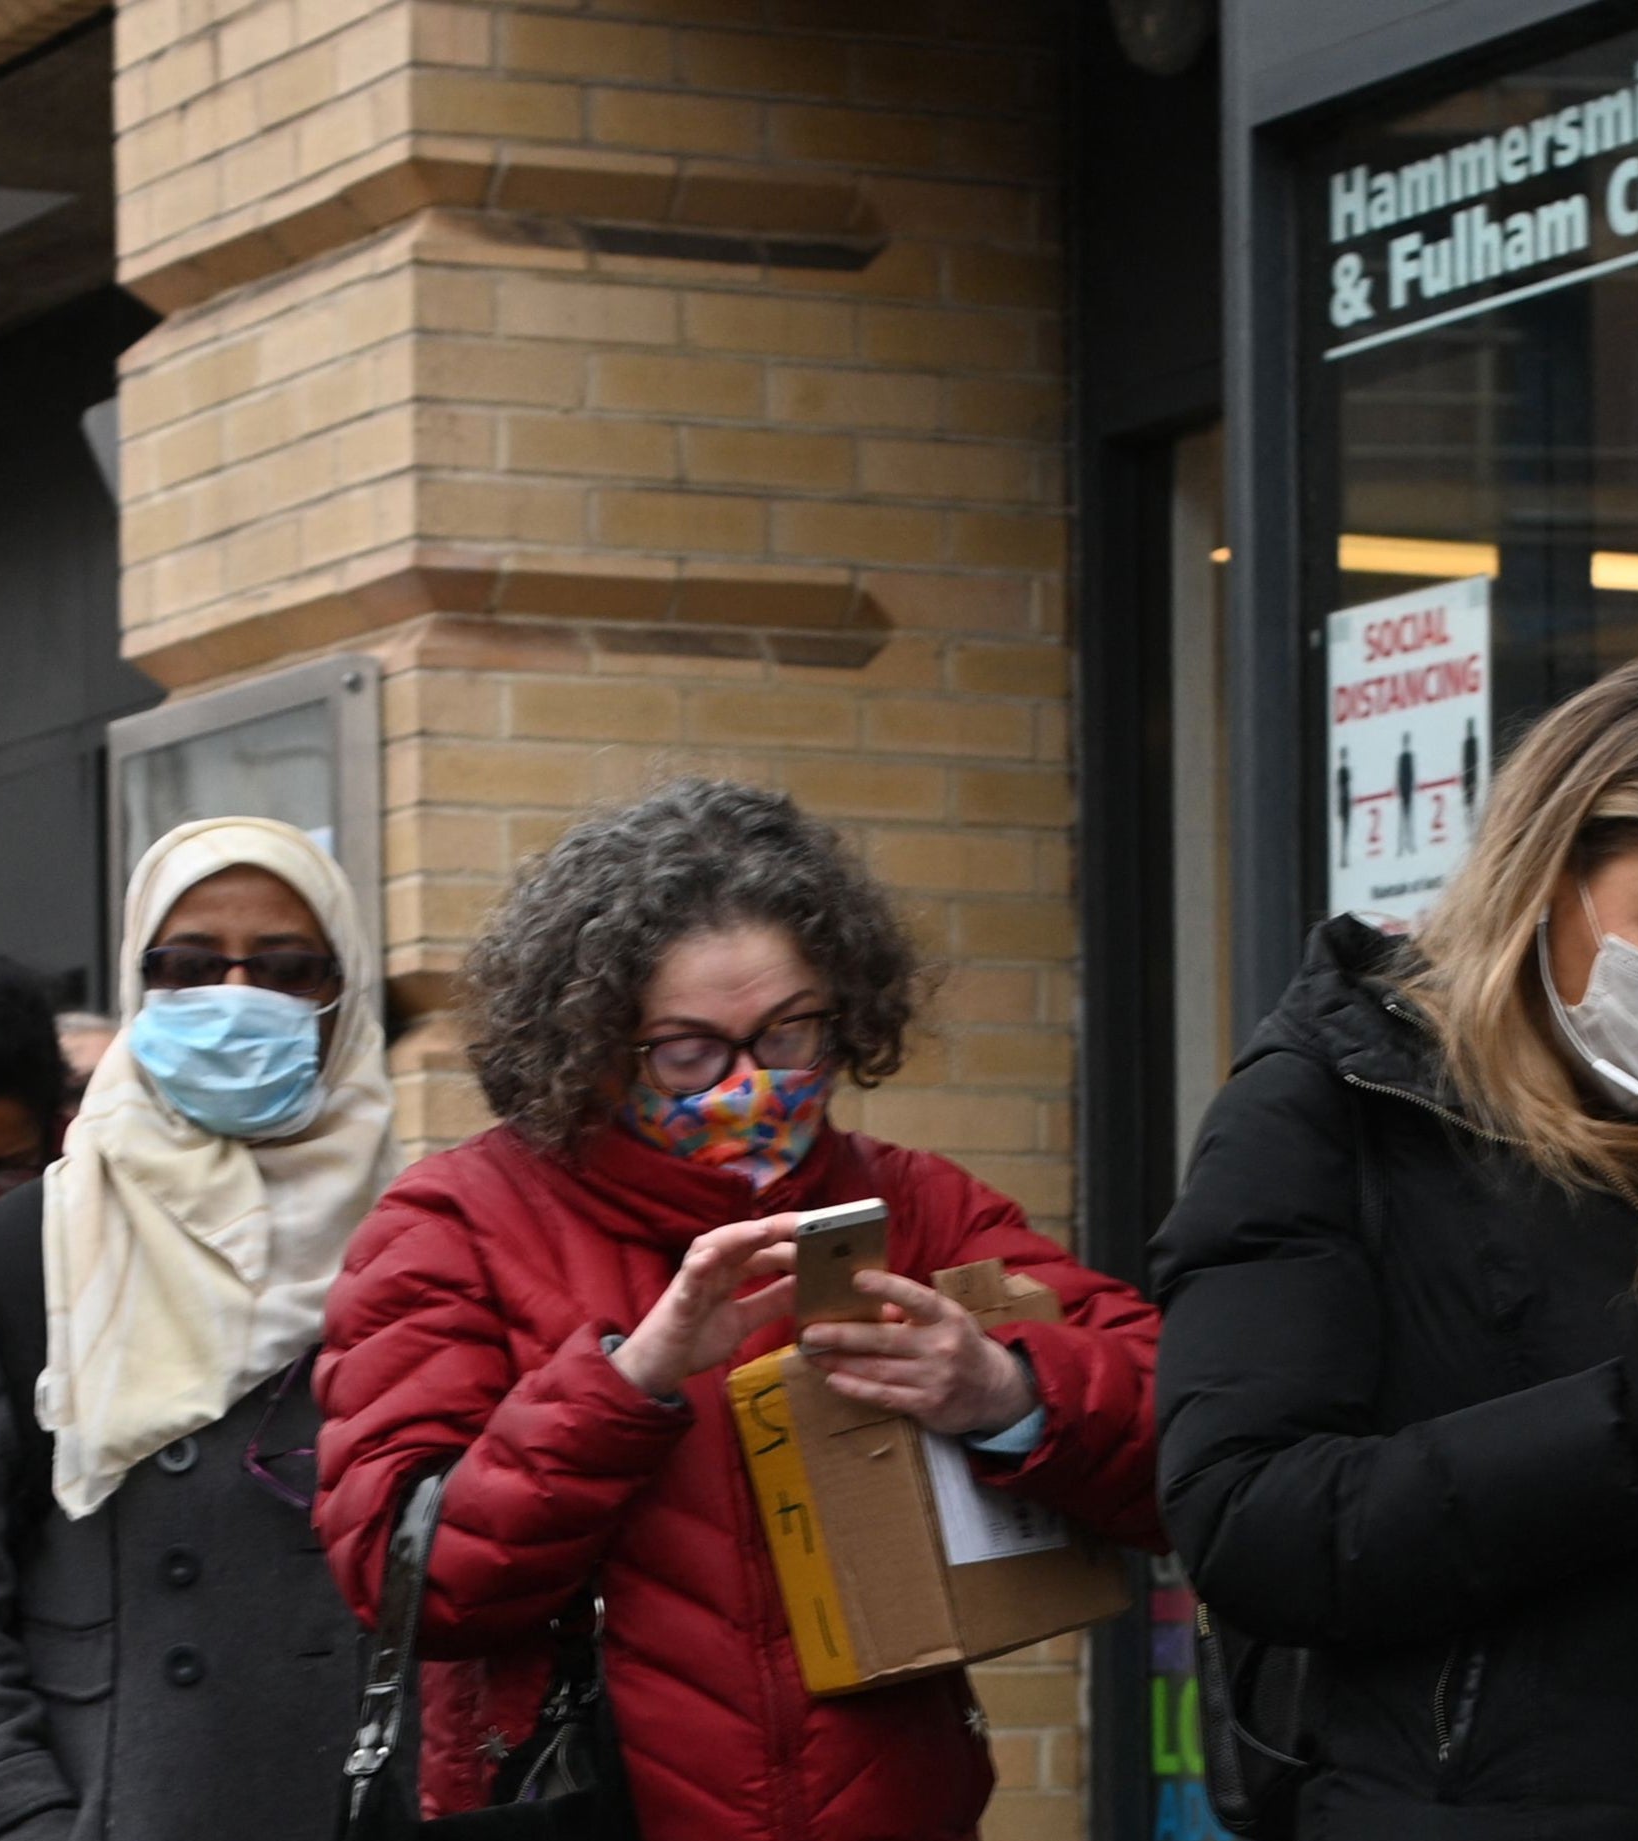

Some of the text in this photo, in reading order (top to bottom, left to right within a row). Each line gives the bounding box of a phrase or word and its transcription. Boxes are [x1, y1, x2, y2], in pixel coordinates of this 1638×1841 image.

[1329, 251, 1376, 328] &
[1387, 193, 1589, 310] Fulham
[1365, 606, 1451, 663] SOCIAL
[1334, 654, 1481, 726] DISTANCING
